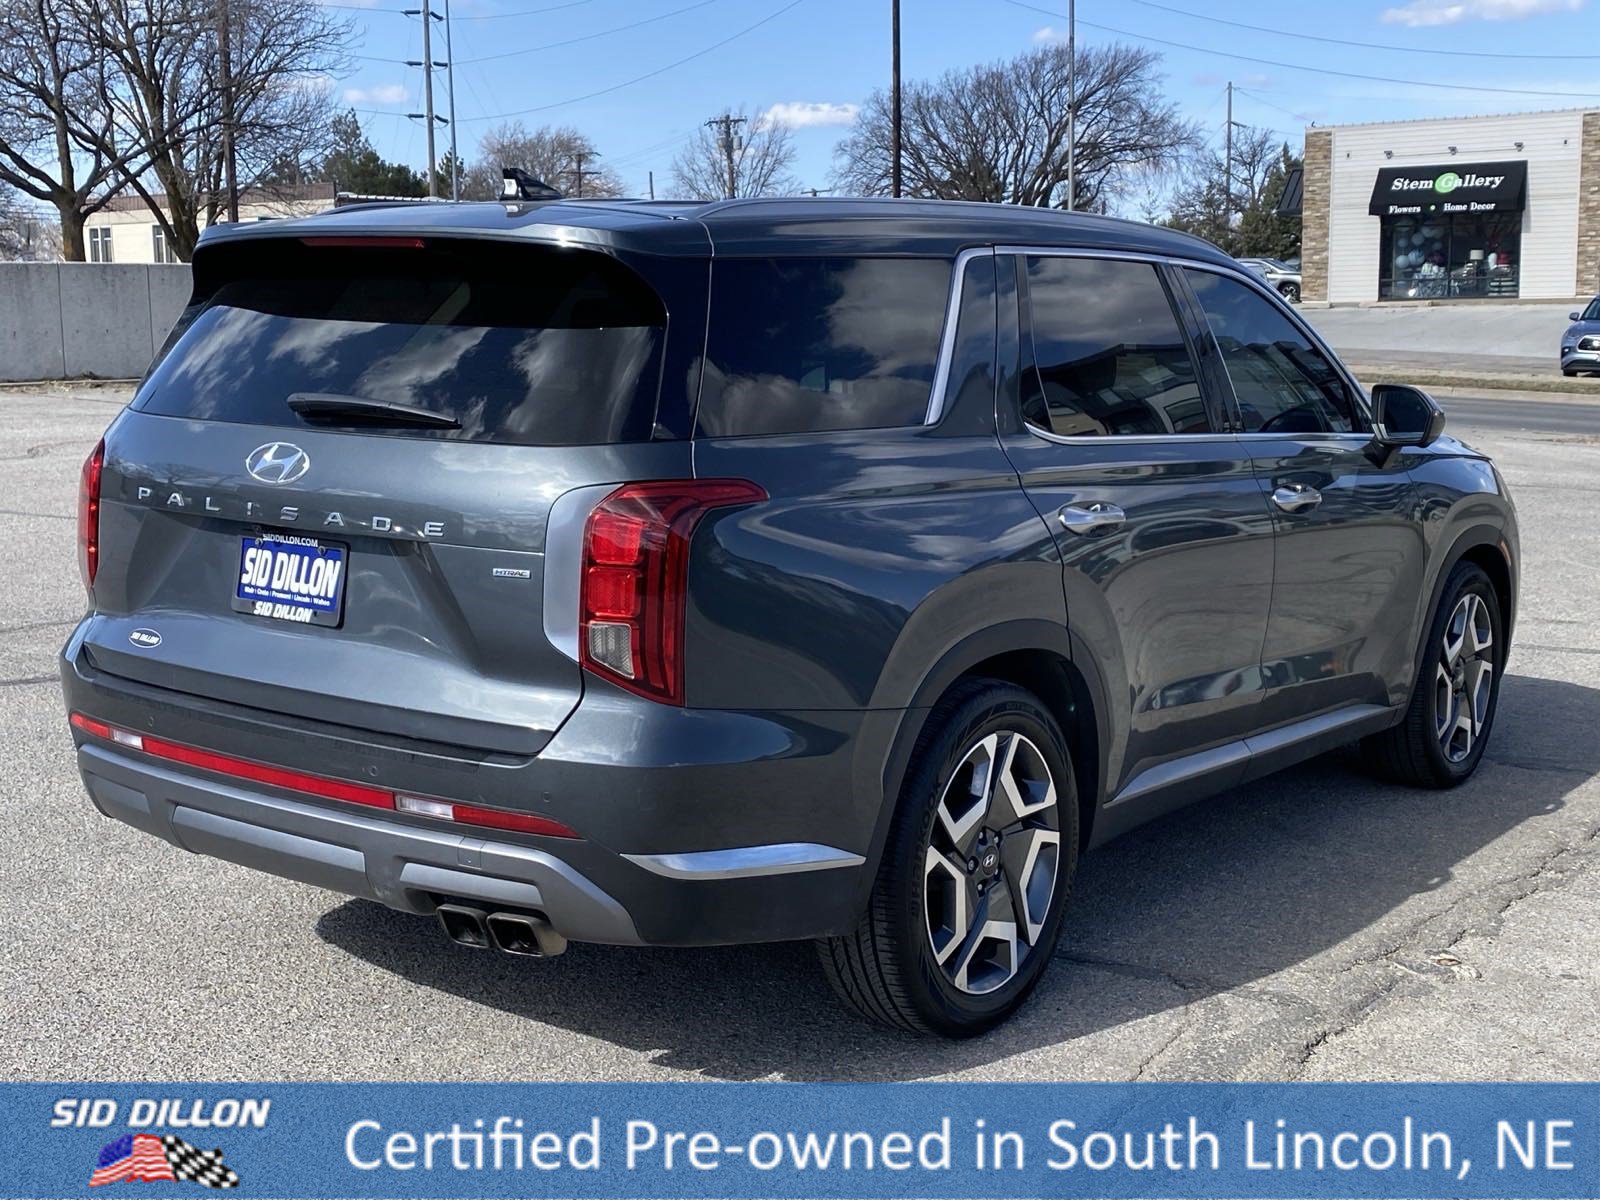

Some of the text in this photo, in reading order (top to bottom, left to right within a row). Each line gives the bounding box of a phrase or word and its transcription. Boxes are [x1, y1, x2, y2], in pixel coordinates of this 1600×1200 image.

[1391, 174, 1505, 190] Stem Gallery
[1388, 202, 1496, 214] Flowers Home Decor
[137, 486, 446, 537] PALISADE
[262, 533, 319, 548] SIDDILLON.COM
[241, 547, 341, 599] SID DILLON
[494, 569, 529, 577] HTRAC
[253, 601, 313, 623] SID DILLON
